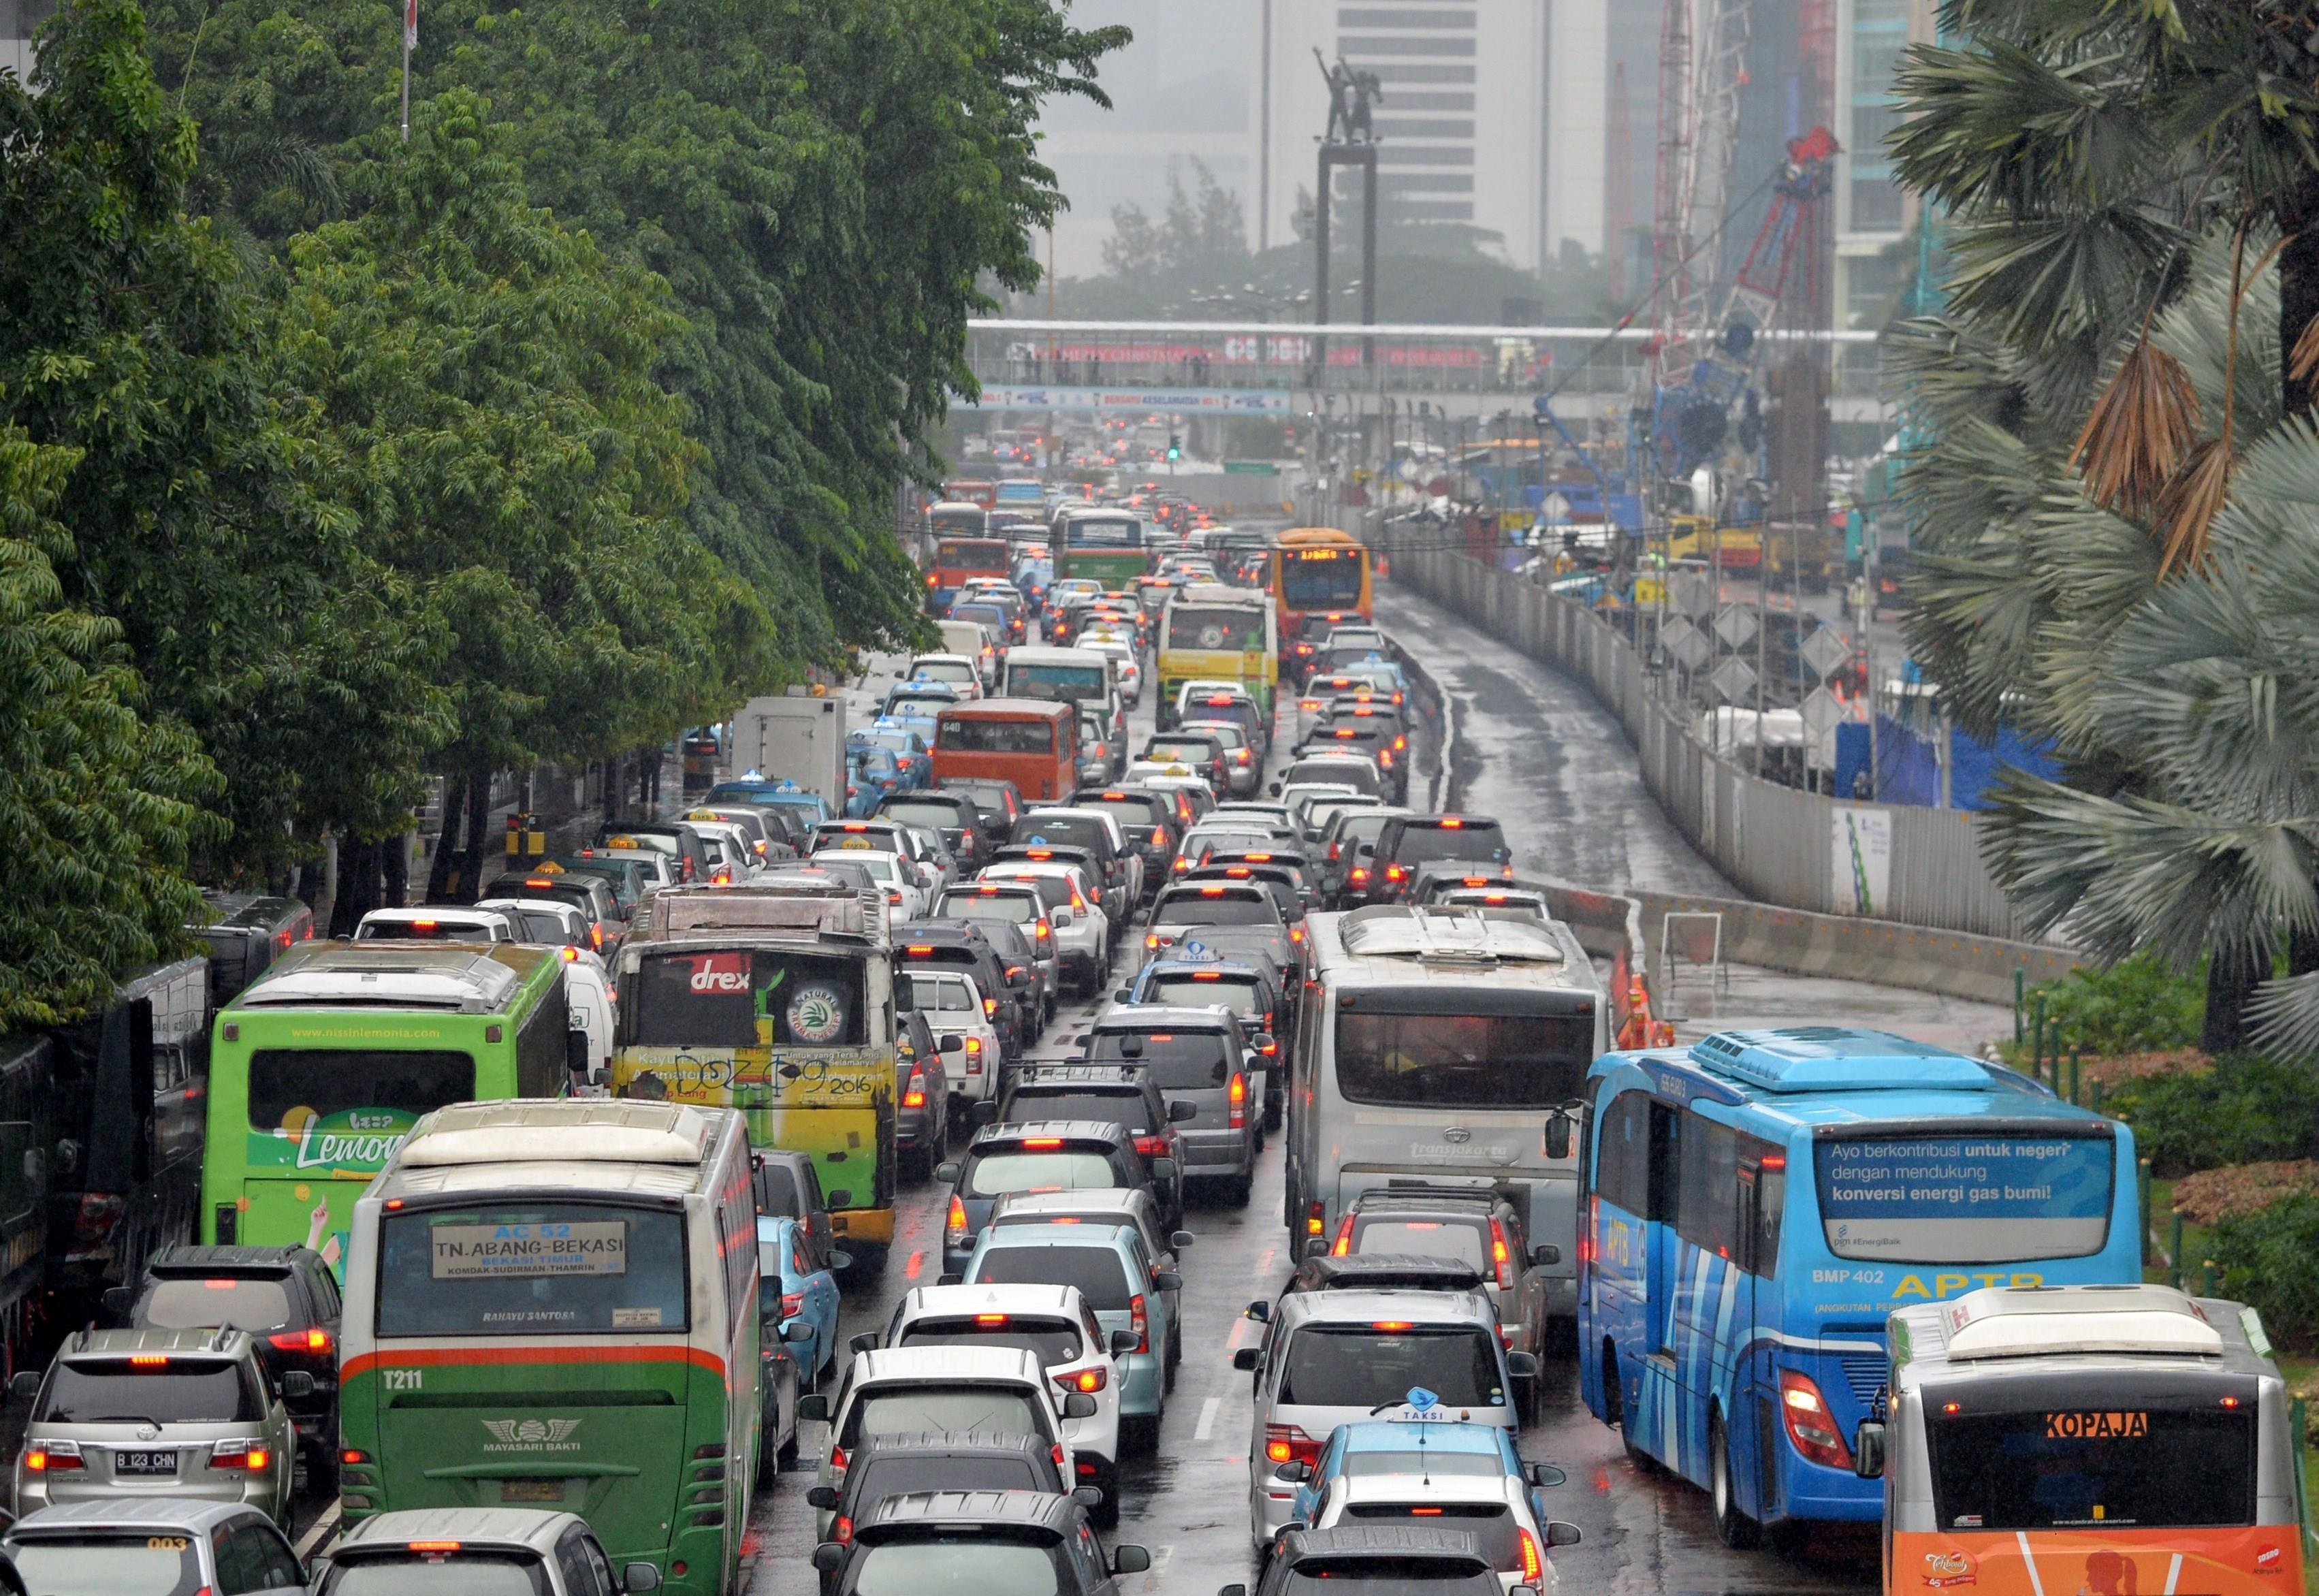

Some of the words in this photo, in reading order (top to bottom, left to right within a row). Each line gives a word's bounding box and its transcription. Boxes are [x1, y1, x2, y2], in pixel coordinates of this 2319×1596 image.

[690, 959, 751, 991] drex
[797, 991, 836, 1005] NATURAL
[291, 1028, 440, 1038] www.nissinlemonia.com
[638, 1053, 674, 1067] Kayu
[814, 1052, 835, 1061] yang
[830, 1076, 871, 1094] 2016
[1411, 1142, 1507, 1157] transjakarta
[1832, 1144, 1859, 1160] Ayo
[1865, 1143, 1960, 1157] berkontribusi
[1965, 1143, 2010, 1156] untuk
[1832, 1166, 1889, 1181] dengan
[1896, 1165, 1986, 1181] mendukung
[1833, 1186, 1904, 1200] konversi
[1910, 1185, 1964, 1202] energi
[1969, 1189, 1999, 1202] gas
[2005, 1185, 2051, 1200] bumi!
[495, 1225, 531, 1240] AC
[541, 1224, 571, 1239] 52
[436, 1239, 624, 1258] TN.ABANG-BEKASI
[1834, 1238, 1851, 1247] pgn
[1853, 1238, 1901, 1246] #EnergiBaik
[482, 1256, 534, 1266] BEKASI
[540, 1255, 584, 1264] TIMUR
[1812, 1270, 1851, 1283] BMP
[1853, 1270, 1884, 1284] 402
[483, 1312, 524, 1322] RAHAYU
[383, 1370, 422, 1390] T211
[1404, 1411, 1443, 1420] TAKSI
[2045, 1412, 2147, 1437] KOPAJA
[483, 1443, 543, 1452] MAYASARI
[547, 1442, 580, 1451] BAKTI
[118, 1454, 125, 1466] B
[131, 1453, 148, 1466] 123
[153, 1453, 175, 1466] CHN
[147, 1537, 187, 1552] 003
